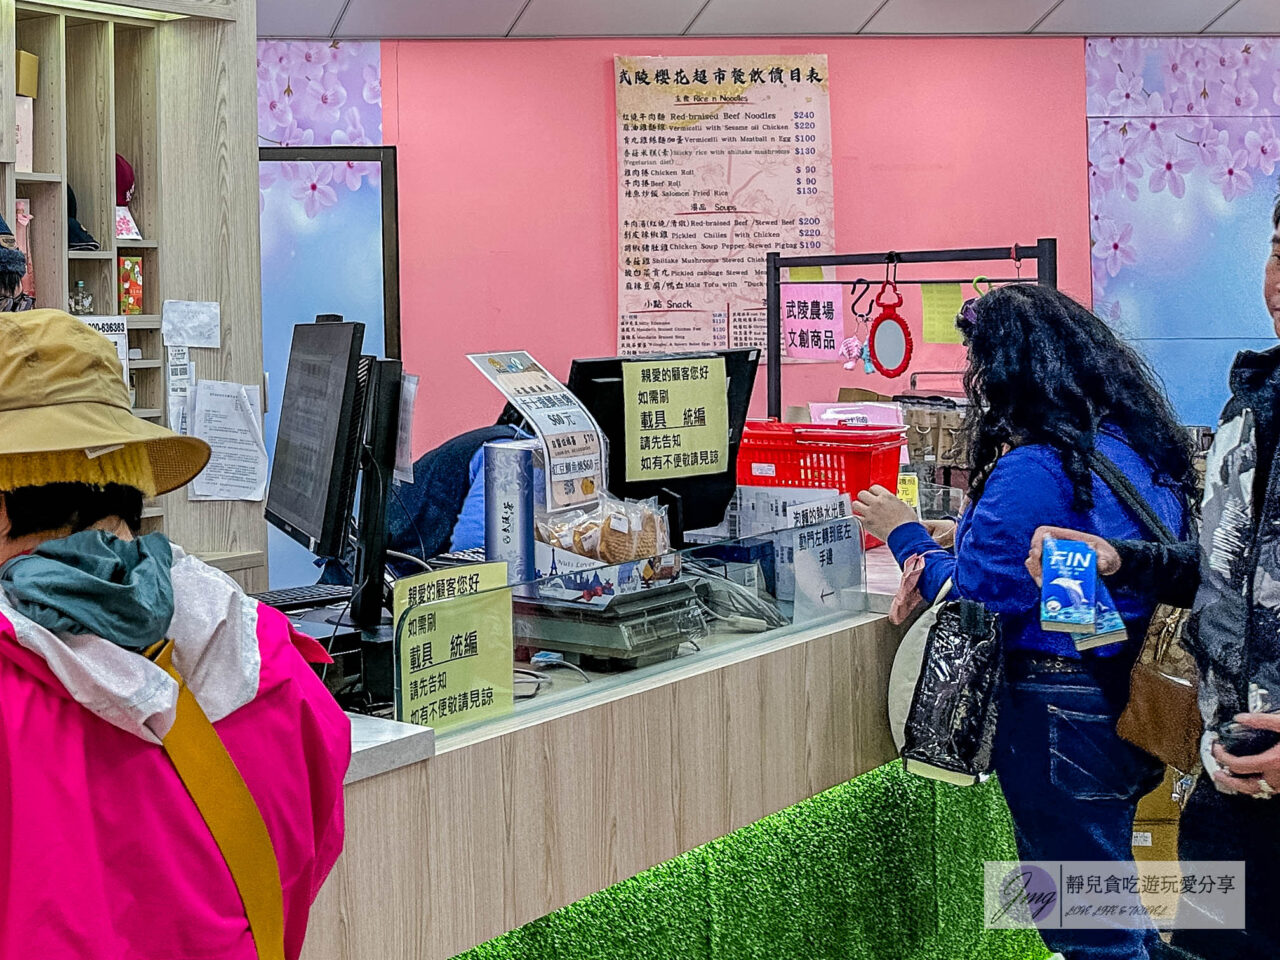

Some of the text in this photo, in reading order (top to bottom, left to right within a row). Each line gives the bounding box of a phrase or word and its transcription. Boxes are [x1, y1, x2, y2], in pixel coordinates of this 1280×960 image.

[619, 67, 823, 86] 武陵櫻花超市餐飲價目表
[745, 112, 776, 120] Noodles
[714, 204, 737, 212] Soups
[799, 229, 820, 237] $220
[667, 300, 692, 308] Snack
[786, 300, 834, 320] 武陵農場
[788, 330, 835, 350] 文創商品
[641, 366, 709, 383] 親愛的顧客您好
[638, 390, 669, 405] 如需刷
[640, 407, 705, 428] 載具 統編
[640, 434, 681, 451] 請先告知
[640, 450, 718, 470] 如有不便敬請見諒
[799, 522, 852, 551] 動門左轉到底左
[820, 548, 833, 567] 手邊
[1048, 551, 1092, 567] FIN
[408, 573, 480, 607] 親愛的顧客您好
[408, 612, 436, 638] 如需刷
[410, 631, 478, 671] 載具 統編
[410, 672, 447, 701] 請先告知
[411, 687, 494, 726] 如有不便敬請見諒
